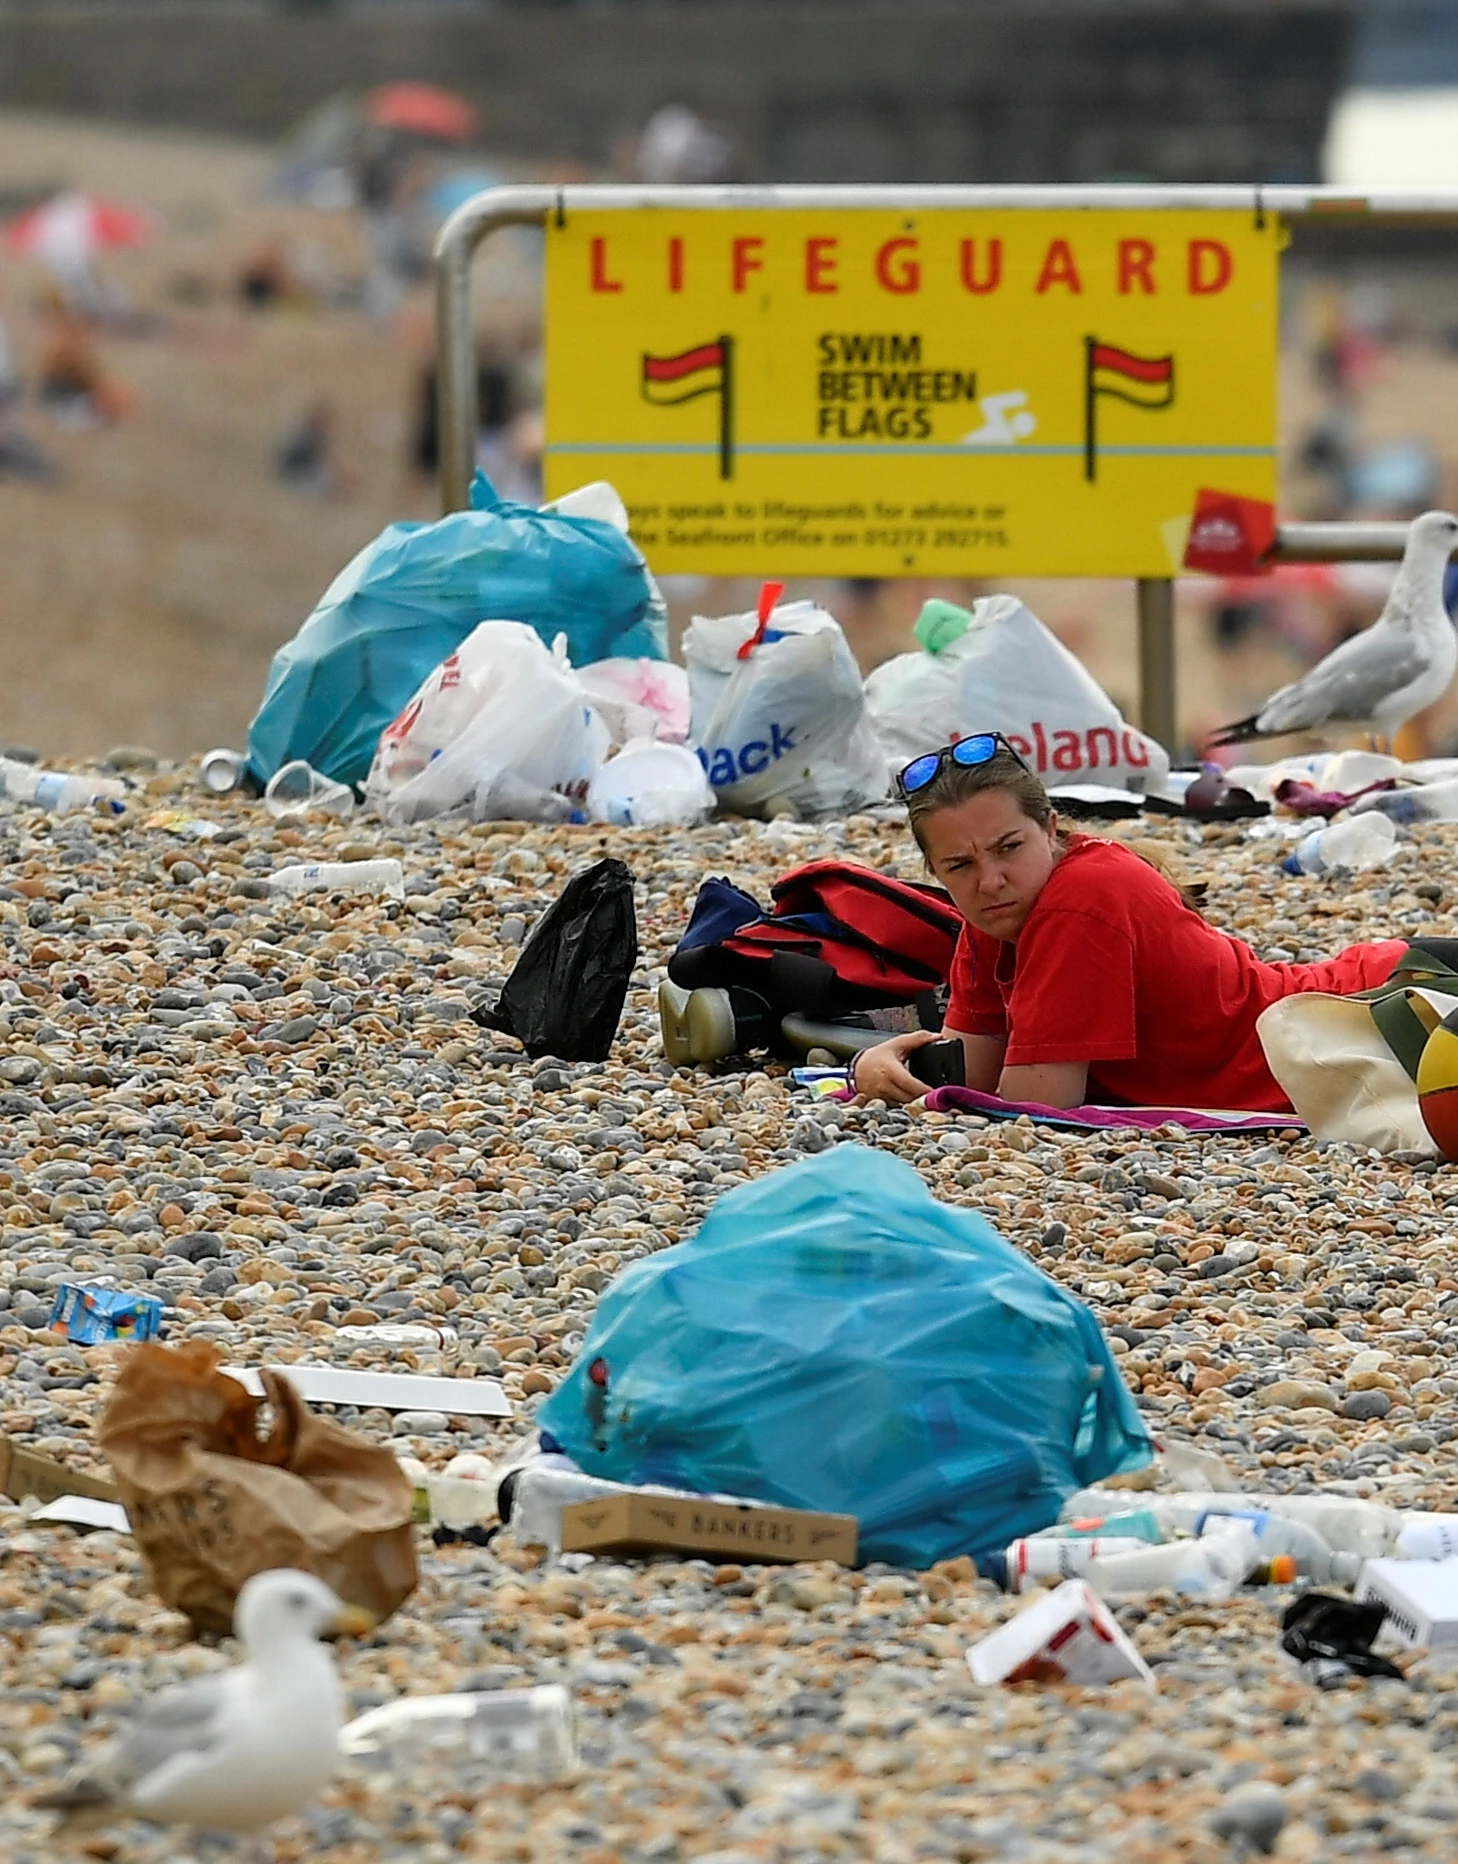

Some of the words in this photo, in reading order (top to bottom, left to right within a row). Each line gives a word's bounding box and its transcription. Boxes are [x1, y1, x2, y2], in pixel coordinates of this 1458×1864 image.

[590, 235, 1235, 297] LIFEGUARD
[817, 333, 922, 366] SWIM
[817, 370, 977, 403] BETWEEN
[817, 406, 933, 440] FLAGS
[667, 500, 725, 522] speak
[735, 503, 754, 519] to
[763, 500, 865, 525] lifeguards
[874, 500, 903, 519] for
[911, 501, 975, 520] advice
[984, 505, 1004, 520] or
[666, 528, 755, 548] Seafront
[763, 528, 824, 546] Office
[831, 533, 857, 547] on
[864, 530, 925, 547] 01273
[696, 722, 797, 787] ack
[691, 1512, 795, 1545] BANKERS
